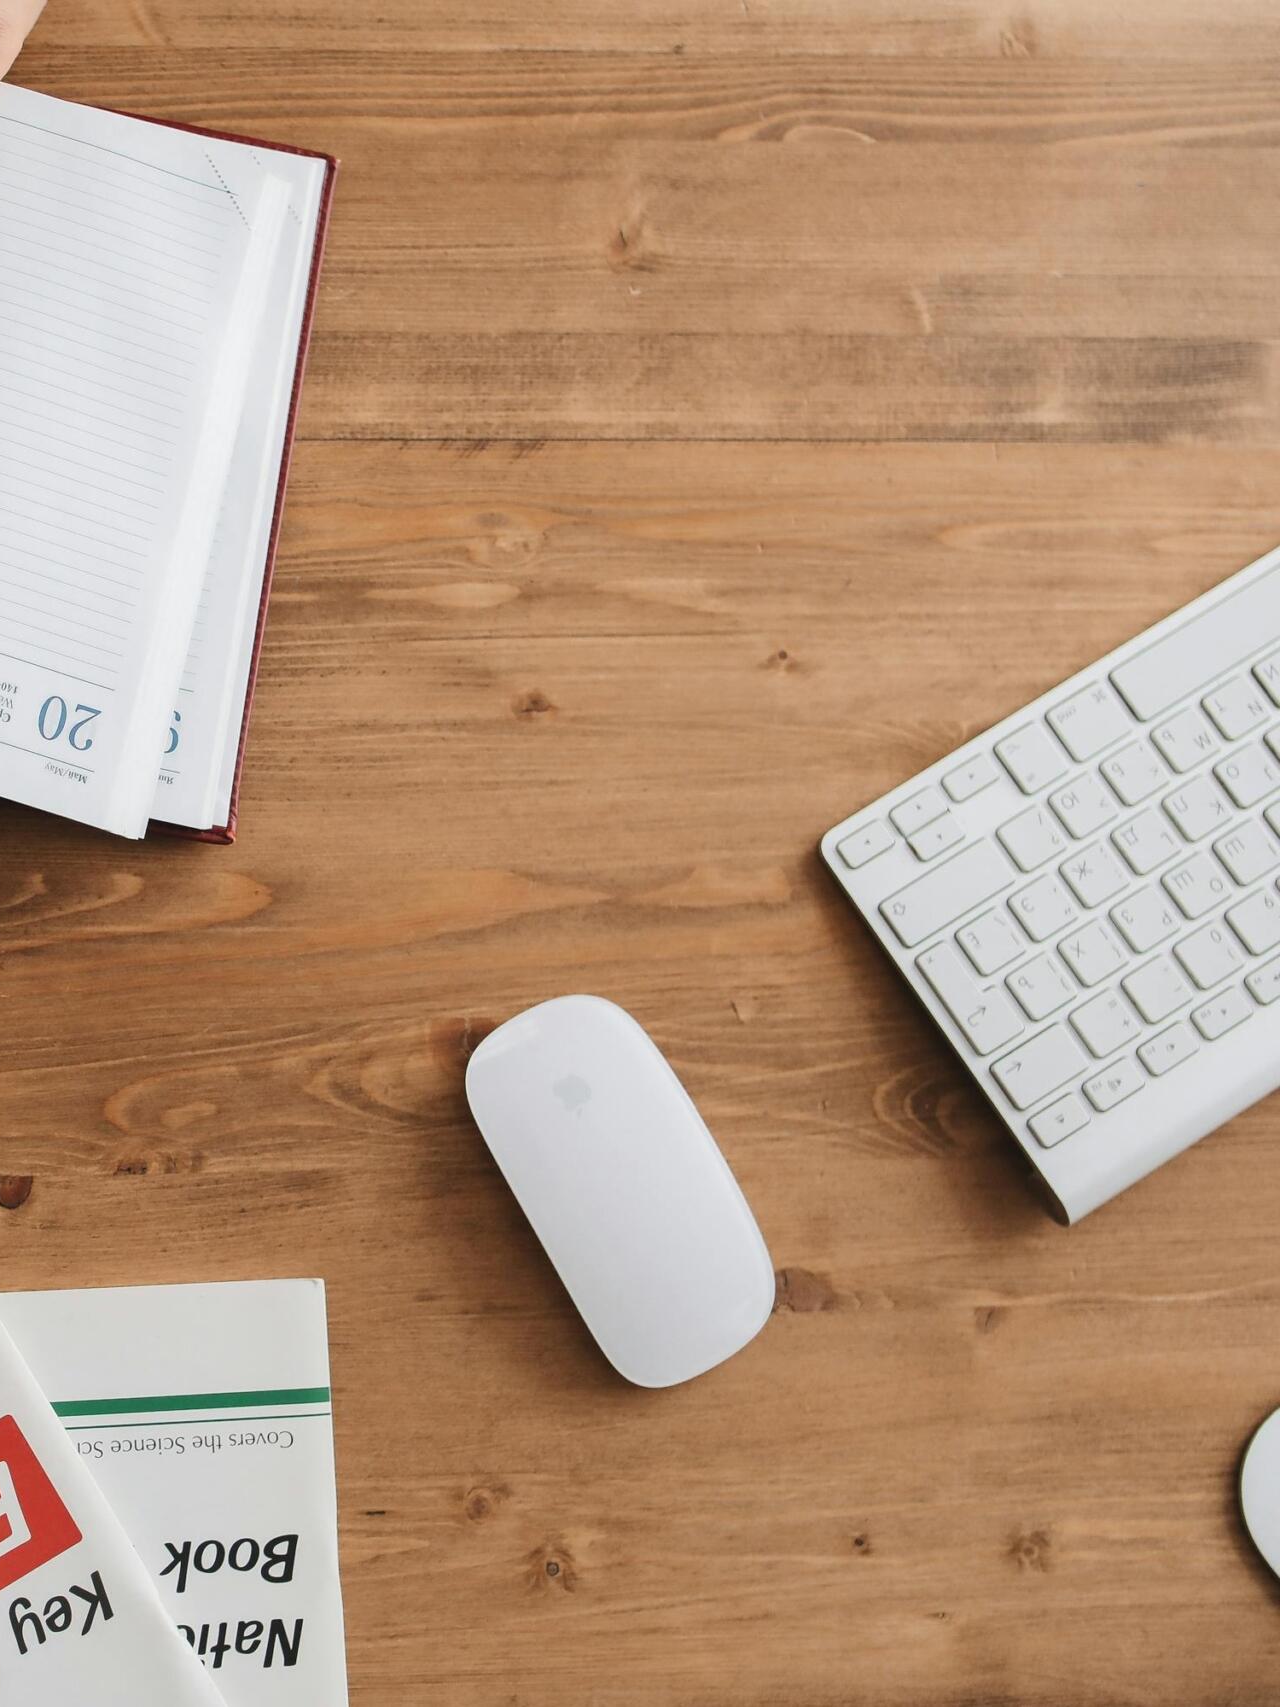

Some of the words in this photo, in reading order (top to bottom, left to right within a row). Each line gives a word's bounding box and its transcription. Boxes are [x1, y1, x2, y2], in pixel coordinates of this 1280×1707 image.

[38, 696, 102, 751] 20
[44, 762, 87, 784] Май/May
[110, 1437, 185, 1457] Science
[192, 1435, 221, 1454] the
[229, 1431, 294, 1449] Covers
[159, 1534, 299, 1593] Book
[9, 1570, 114, 1654] Key
